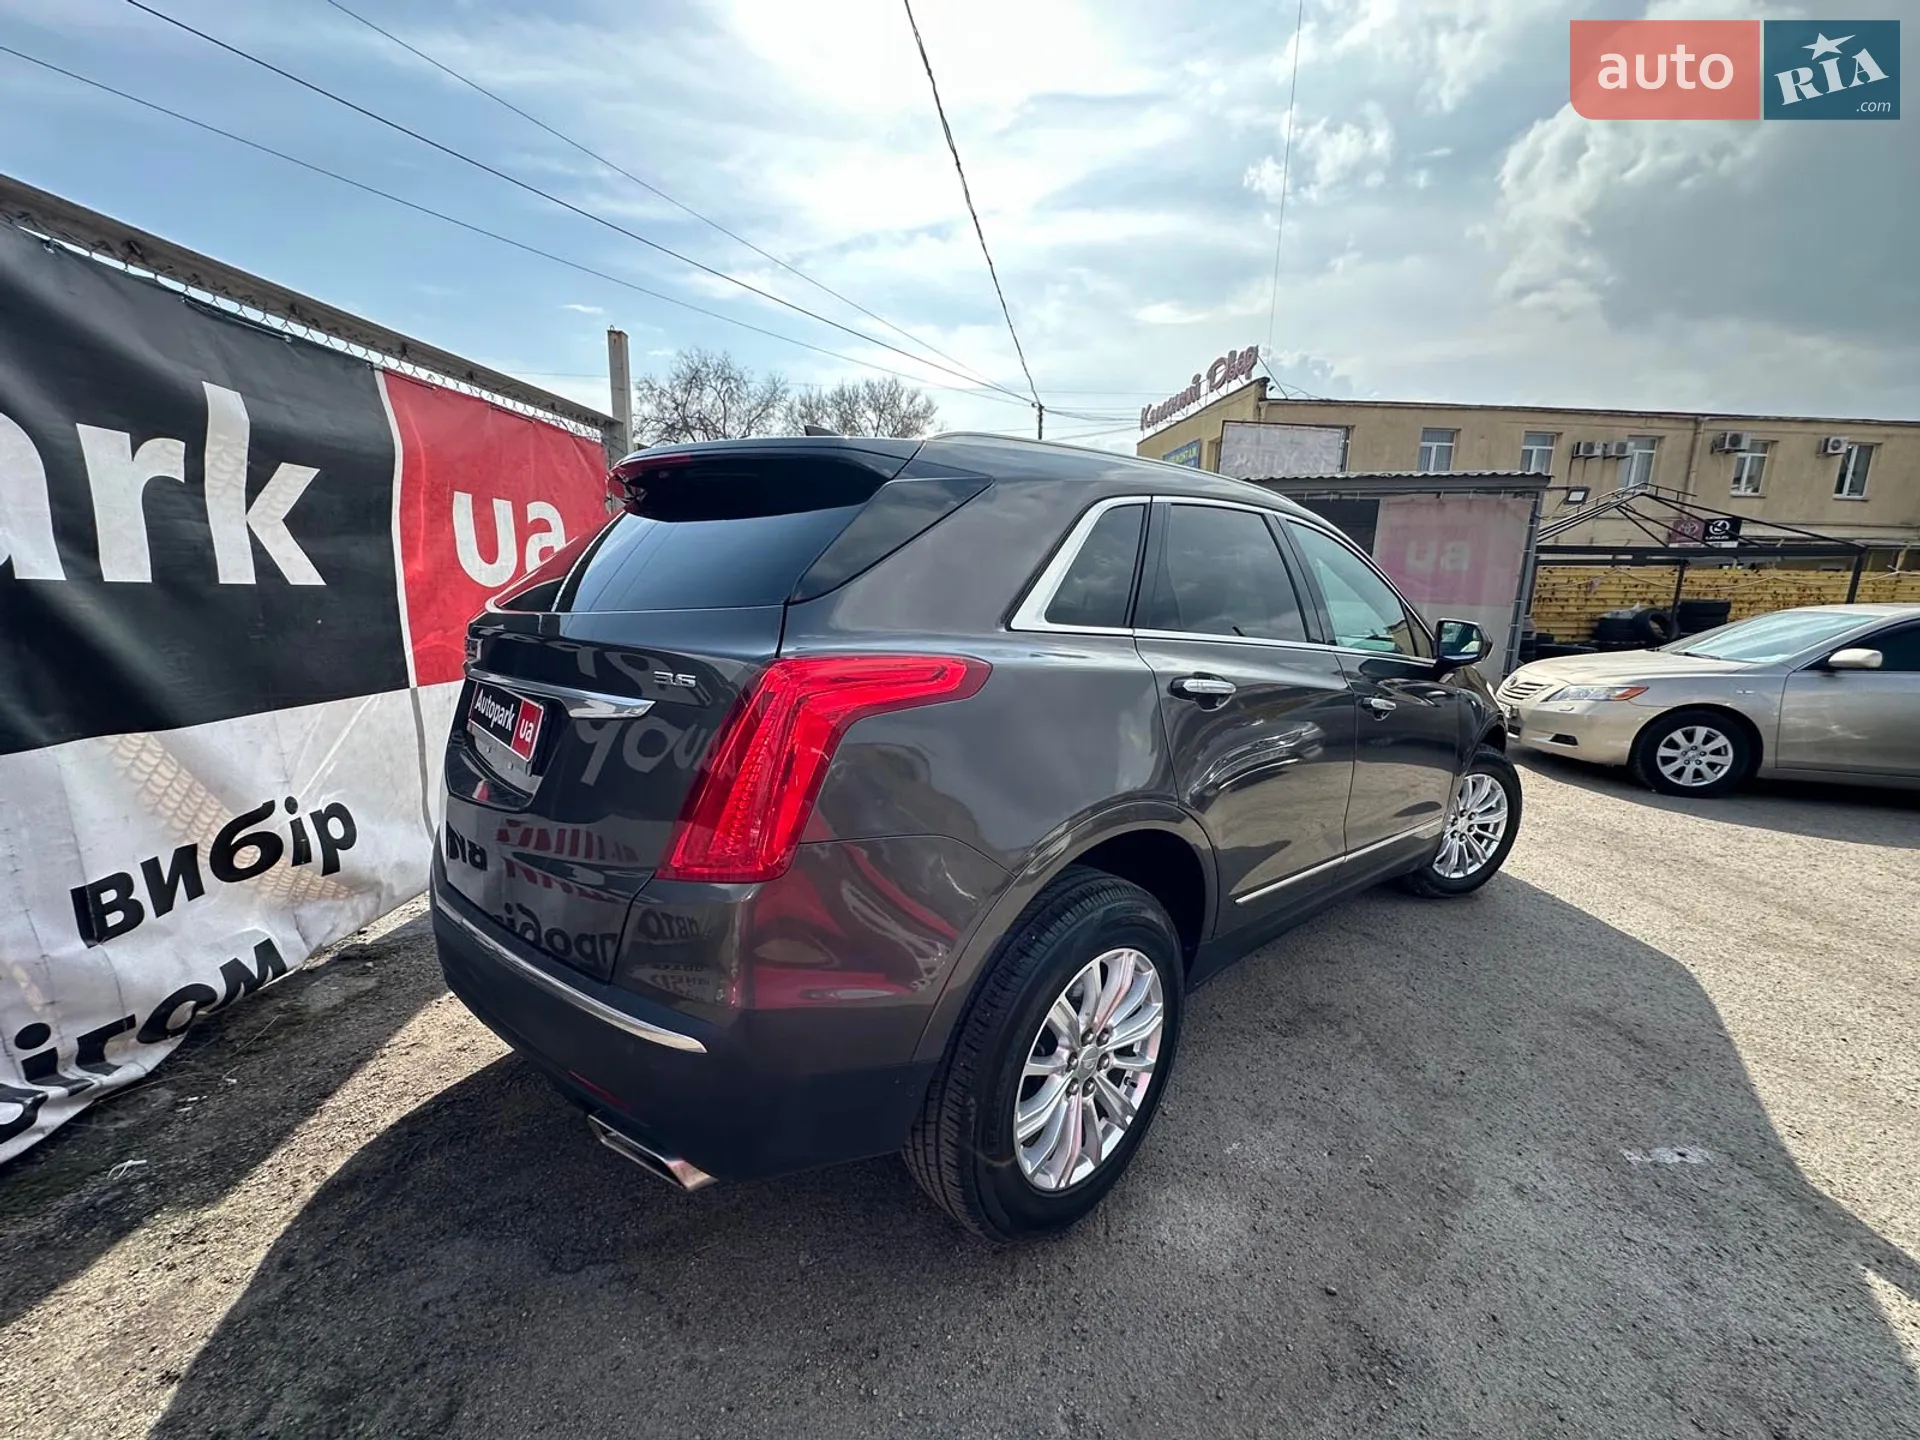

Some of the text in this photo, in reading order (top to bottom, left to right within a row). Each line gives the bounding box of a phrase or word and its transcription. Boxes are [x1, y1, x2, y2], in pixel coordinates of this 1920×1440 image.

[453, 490, 566, 588] ua
[474, 688, 535, 743] Autopark ua
[70, 795, 358, 948] вибір
